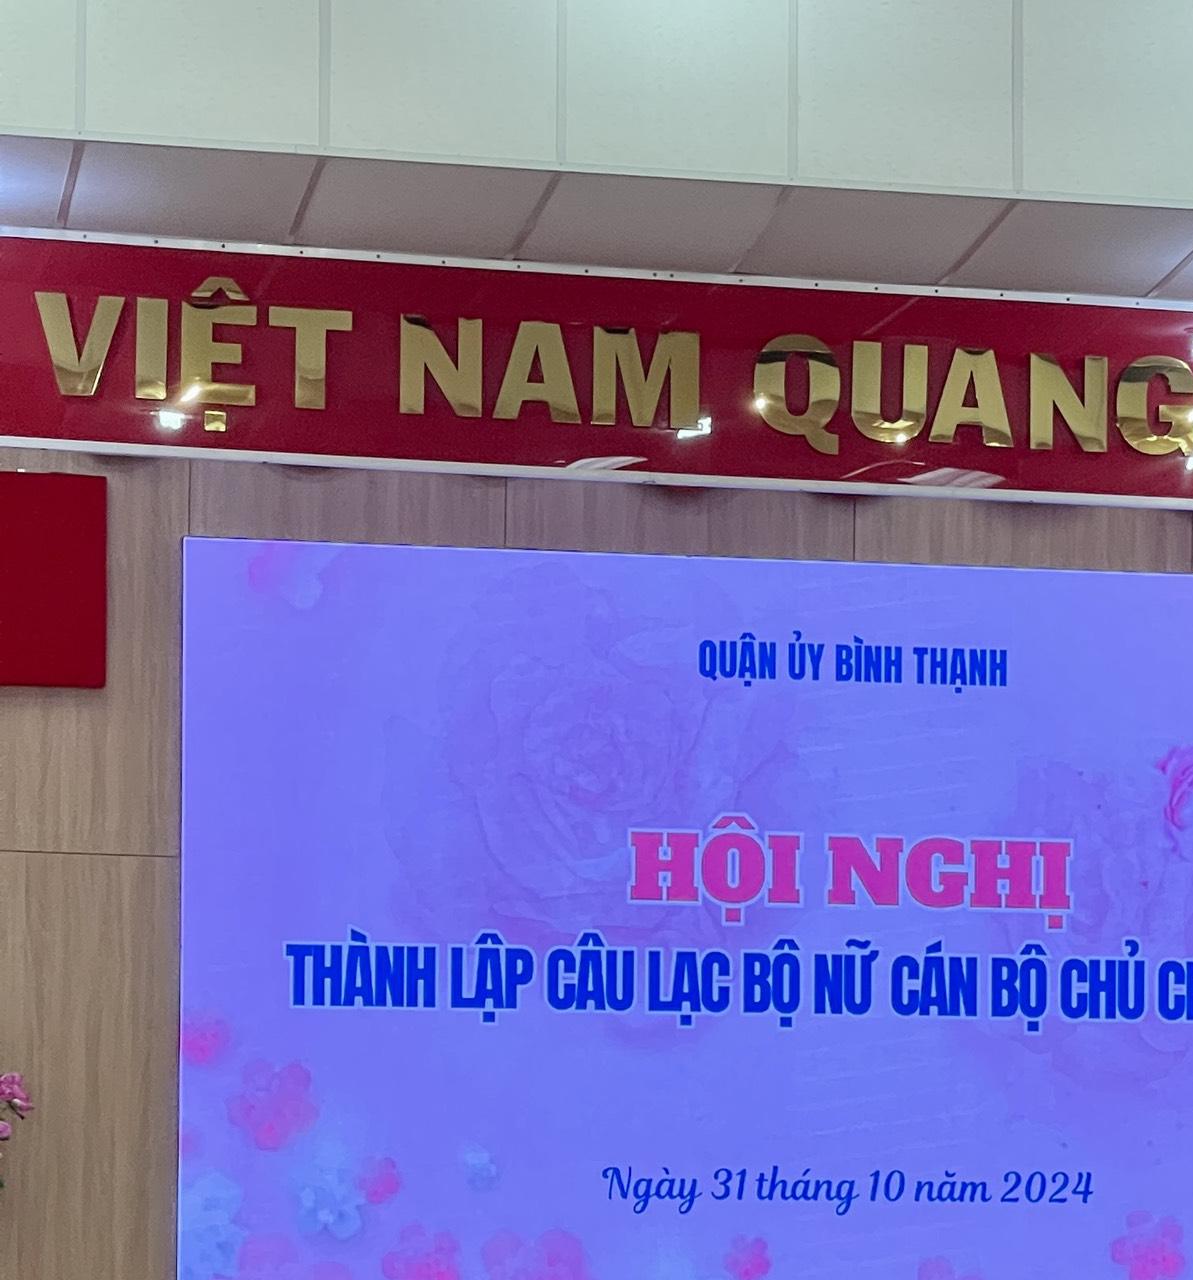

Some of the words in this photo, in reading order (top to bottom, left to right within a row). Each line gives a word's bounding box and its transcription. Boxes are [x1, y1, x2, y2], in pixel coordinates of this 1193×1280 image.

[34, 276, 353, 432] VIỆT
[399, 313, 700, 428] NAM
[699, 631, 777, 688] QUẬN
[788, 630, 826, 682] ỦY
[835, 634, 903, 684] BÌNH
[912, 646, 1008, 694] THẠNH
[629, 814, 802, 923] HỘI
[826, 835, 1072, 930] NGHỊ
[284, 928, 438, 1009] THÀNH
[450, 931, 534, 1024] LẬP
[546, 931, 636, 1014] CÂU
[648, 949, 731, 1027] LẠC
[742, 938, 801, 1029] BỘ
[813, 939, 880, 1016] NỮ
[890, 939, 979, 1018] CÁN
[990, 944, 1047, 1033] BỘ
[1059, 939, 1146, 1023] CHỦ
[601, 1166, 703, 1214] Ngày
[711, 1168, 747, 1201] 31
[755, 1165, 860, 1216] tháng
[869, 1169, 906, 1202] 10
[914, 1170, 993, 1203] năm
[1000, 1170, 1095, 1205] 2024
